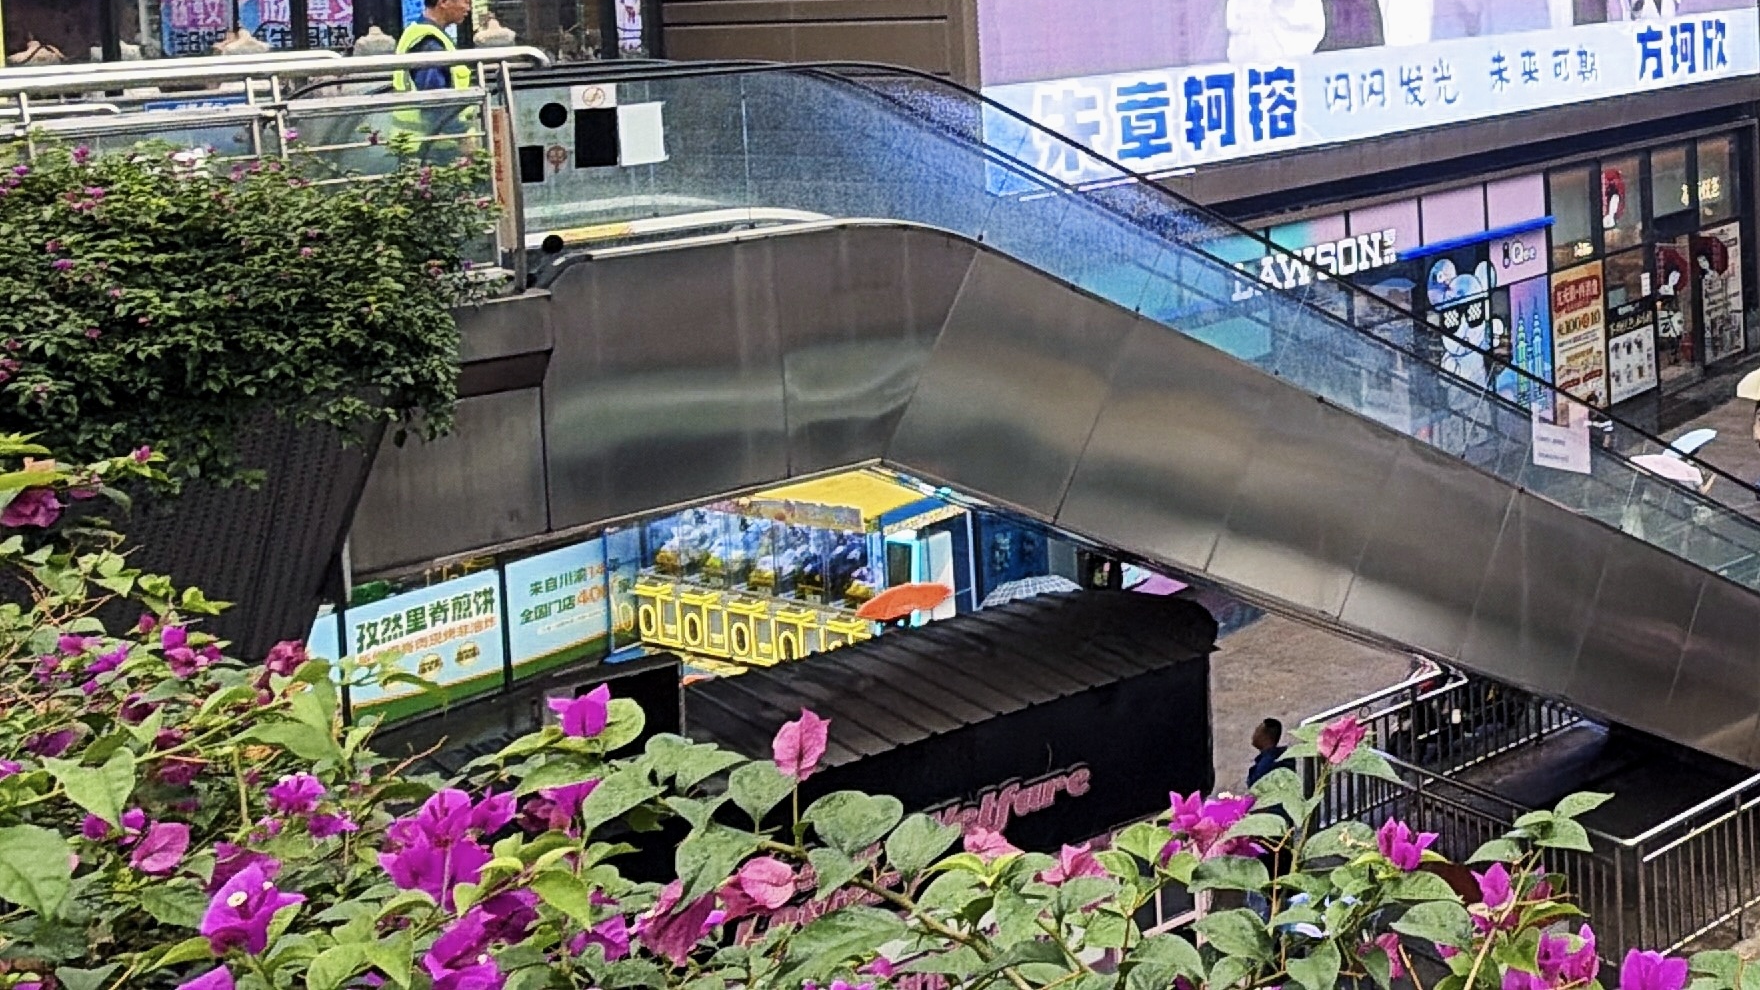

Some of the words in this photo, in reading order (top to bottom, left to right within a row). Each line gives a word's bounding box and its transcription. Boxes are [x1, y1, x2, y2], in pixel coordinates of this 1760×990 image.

[1323, 58, 1459, 111] 闪闪发光
[1489, 45, 1599, 92] 未来可期
[1636, 18, 1728, 80] 方珂欣
[1232, 231, 1384, 301] LAWSON
[355, 586, 495, 653] 孜然里脊煎饼
